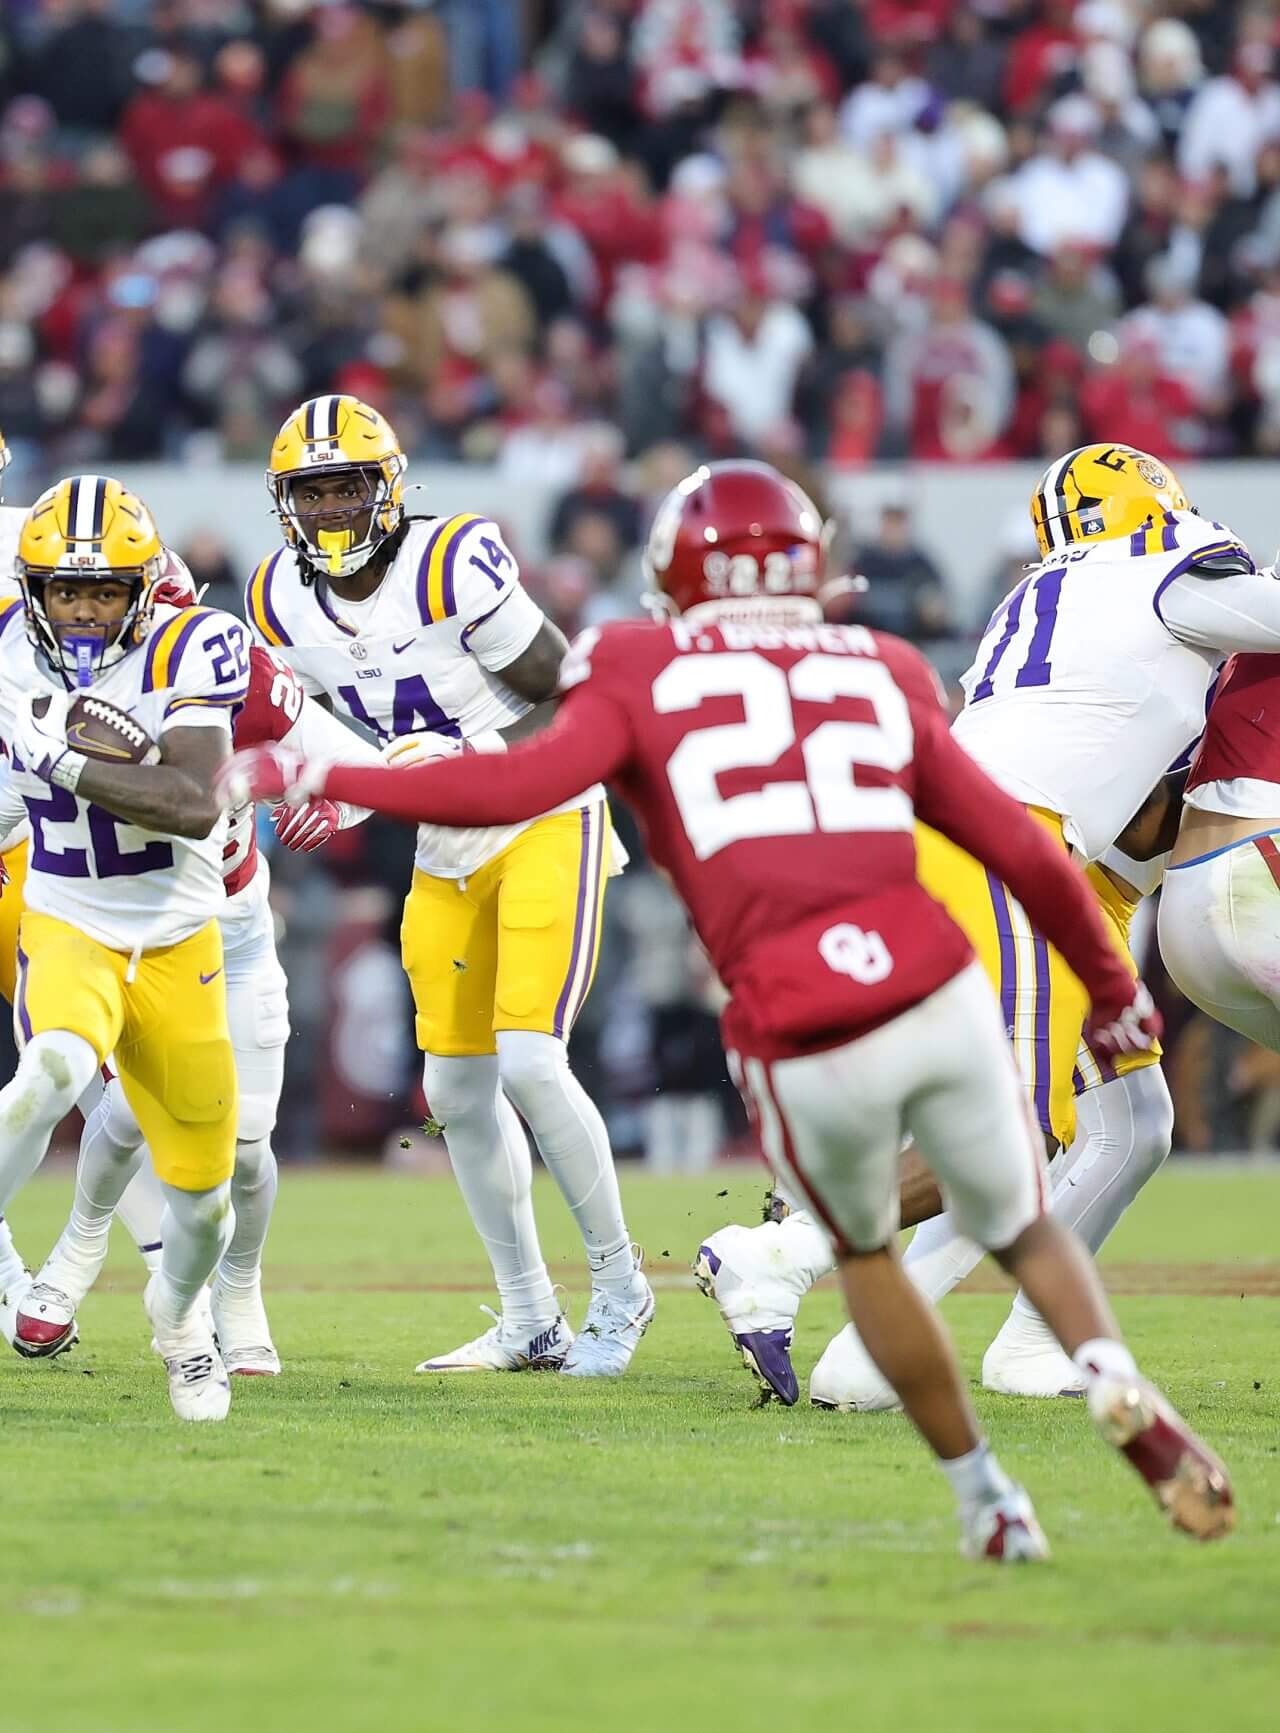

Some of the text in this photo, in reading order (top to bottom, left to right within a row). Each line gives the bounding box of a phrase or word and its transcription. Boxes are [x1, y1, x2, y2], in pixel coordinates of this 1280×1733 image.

[310, 452, 335, 463] LSU
[69, 557, 96, 566] LSU
[468, 535, 513, 592] 14
[202, 624, 250, 686] 22
[969, 567, 1068, 705] 71
[355, 668, 382, 680] LSU
[337, 674, 463, 743] 14
[651, 653, 915, 861] 22
[12, 744, 174, 879] 22
[817, 921, 895, 986] OU
[528, 1324, 562, 1360] NIKE
